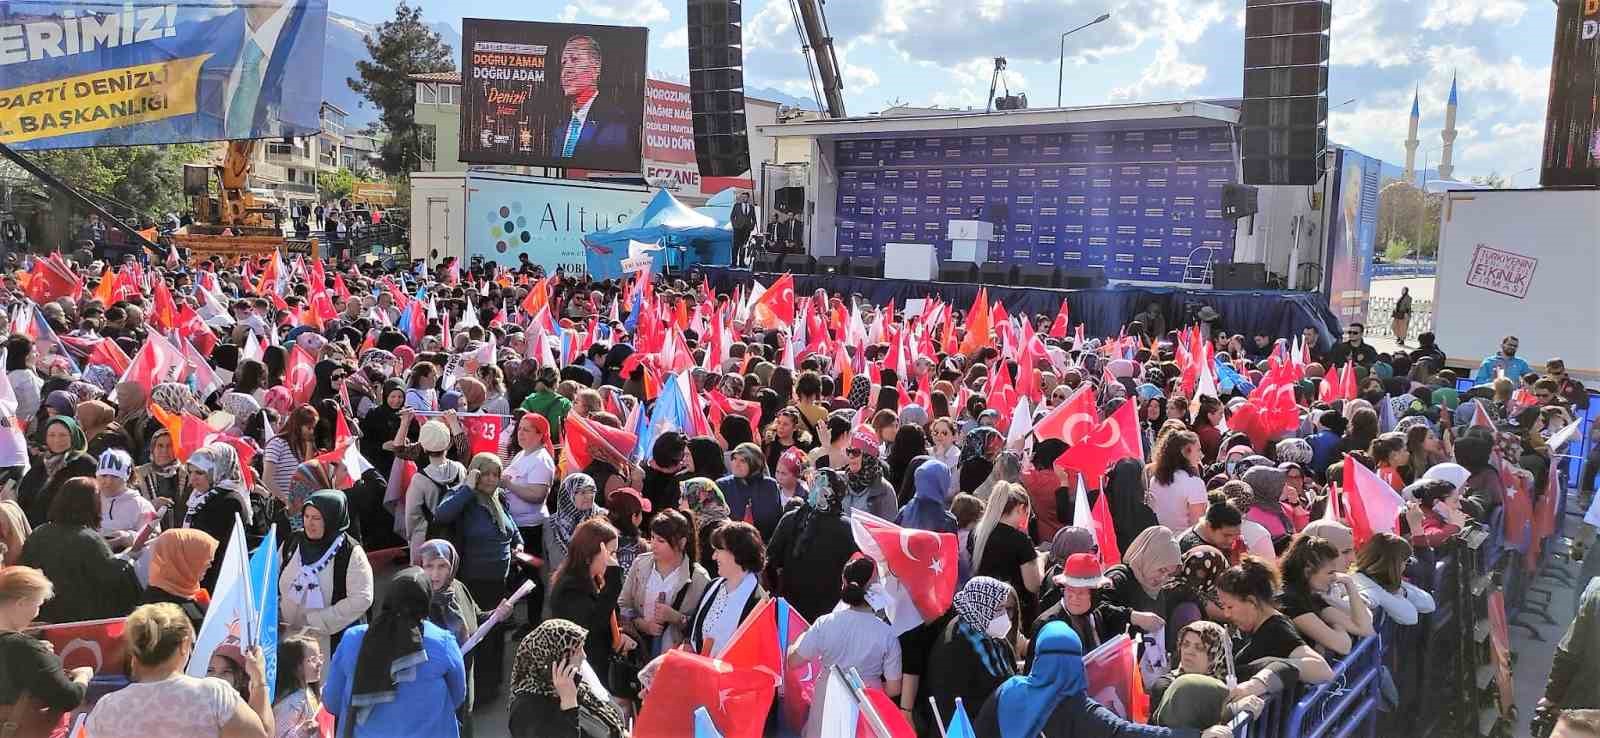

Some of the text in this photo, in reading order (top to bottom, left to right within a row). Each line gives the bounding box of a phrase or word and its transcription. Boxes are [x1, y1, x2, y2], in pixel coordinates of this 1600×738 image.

[474, 54, 544, 68] DOĞRU ZAMAN
[73, 65, 168, 100] DENİZLİ
[473, 67, 544, 81] DOĞRU ADAM
[489, 87, 527, 104] Denizli
[20, 94, 169, 134] BAŞKANLIĞI
[647, 166, 699, 186] ECZANE
